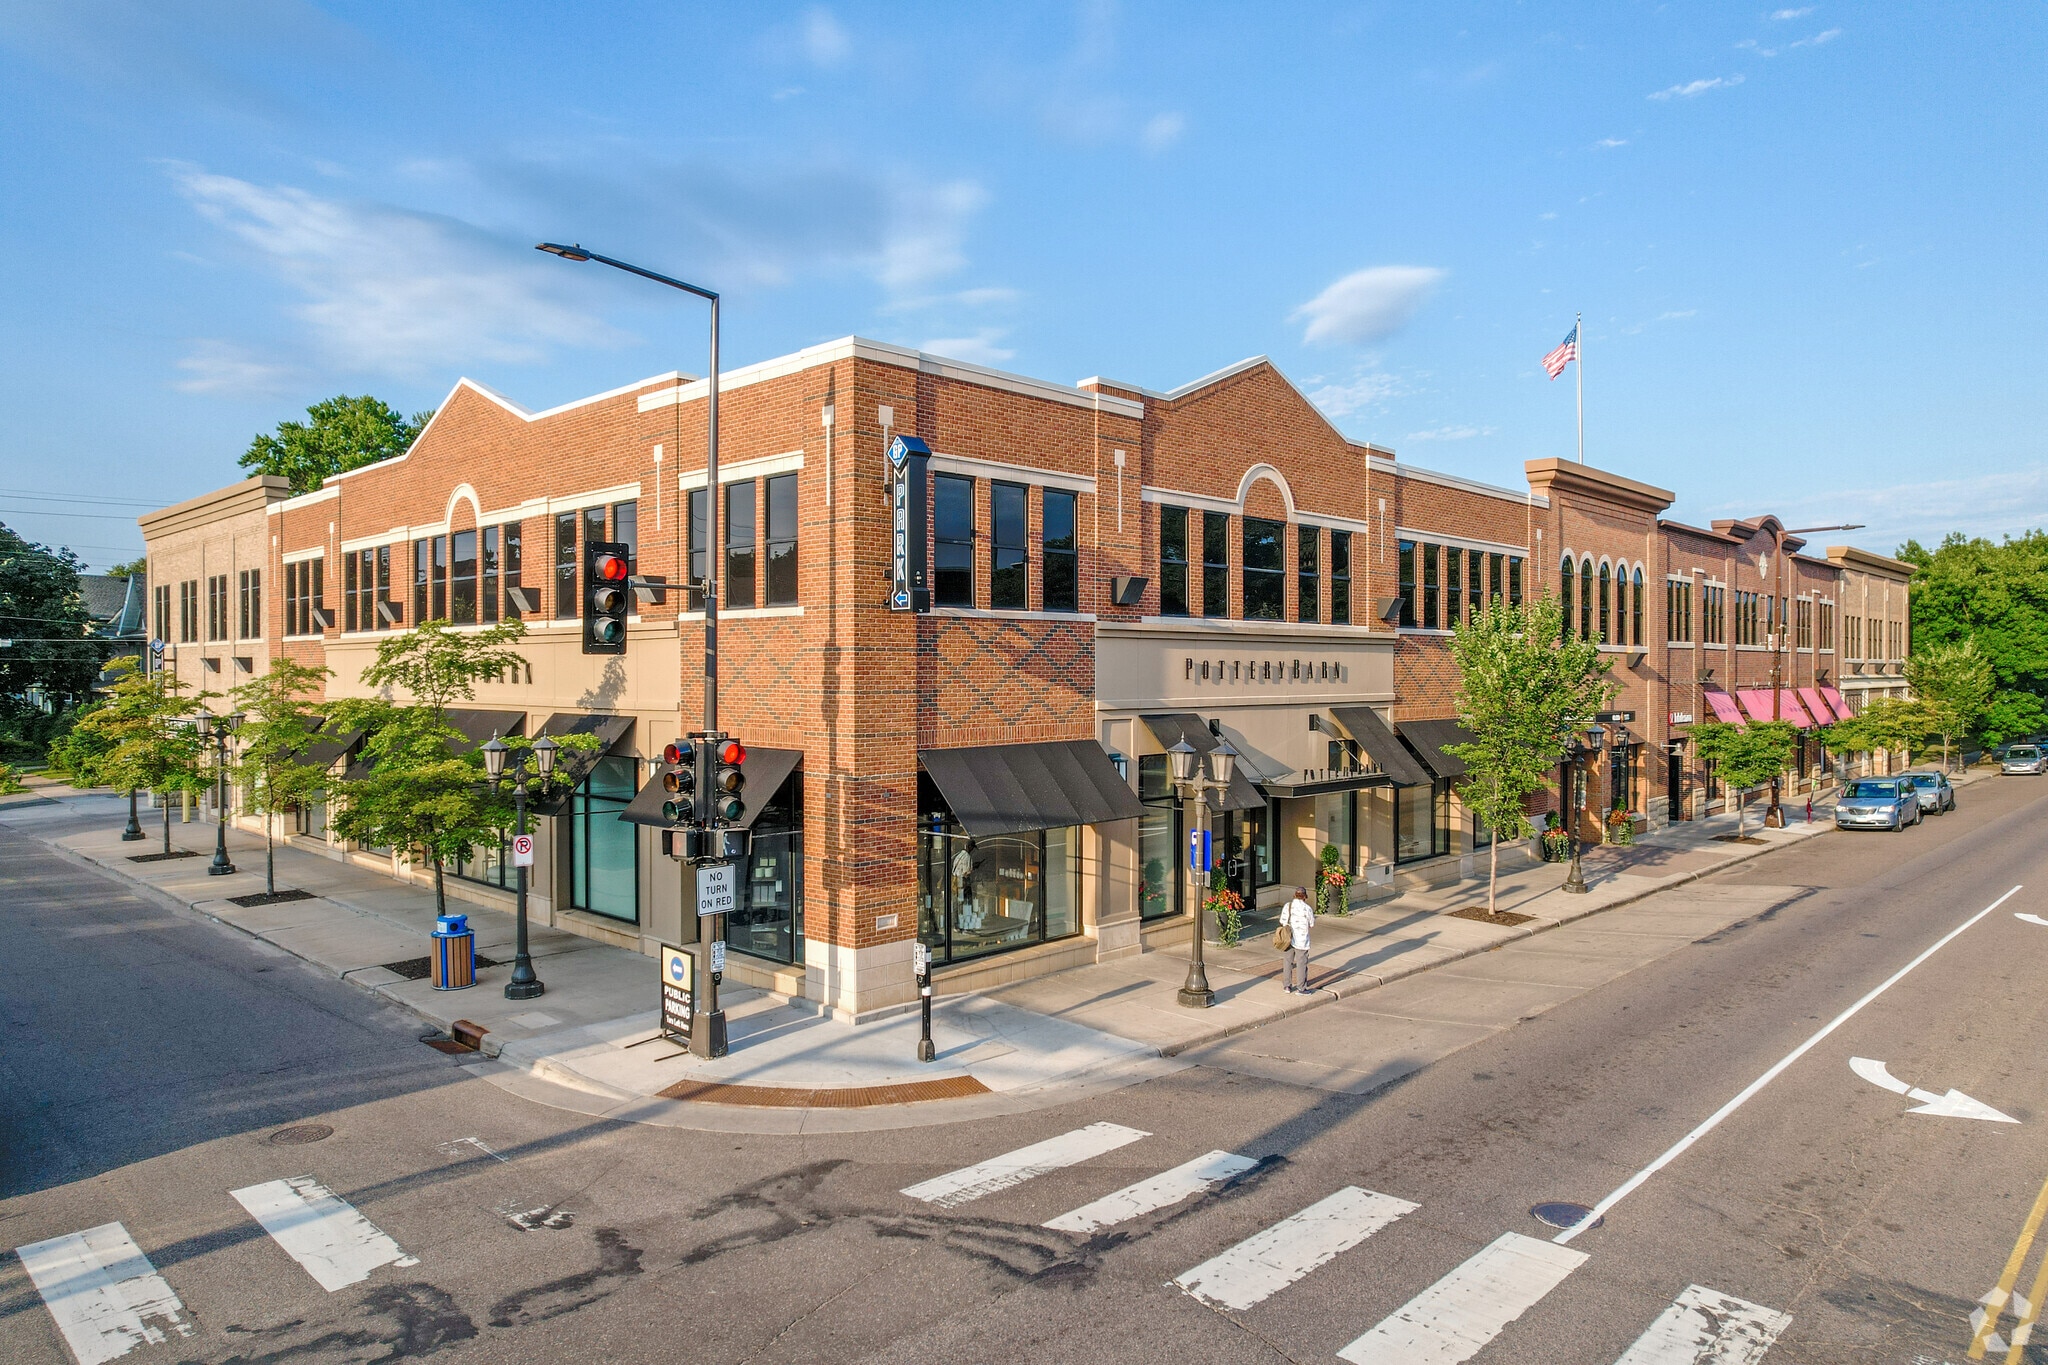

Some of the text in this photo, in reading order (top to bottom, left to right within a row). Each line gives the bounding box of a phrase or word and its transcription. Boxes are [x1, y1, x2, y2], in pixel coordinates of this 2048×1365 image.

[893, 444, 903, 459] GP
[896, 483, 904, 581] PARK
[709, 872, 723, 882] NO
[706, 884, 727, 895] TURN
[701, 895, 732, 909] ON RED
[664, 985, 691, 1003] PUBLIC
[665, 998, 690, 1020] PARKING
